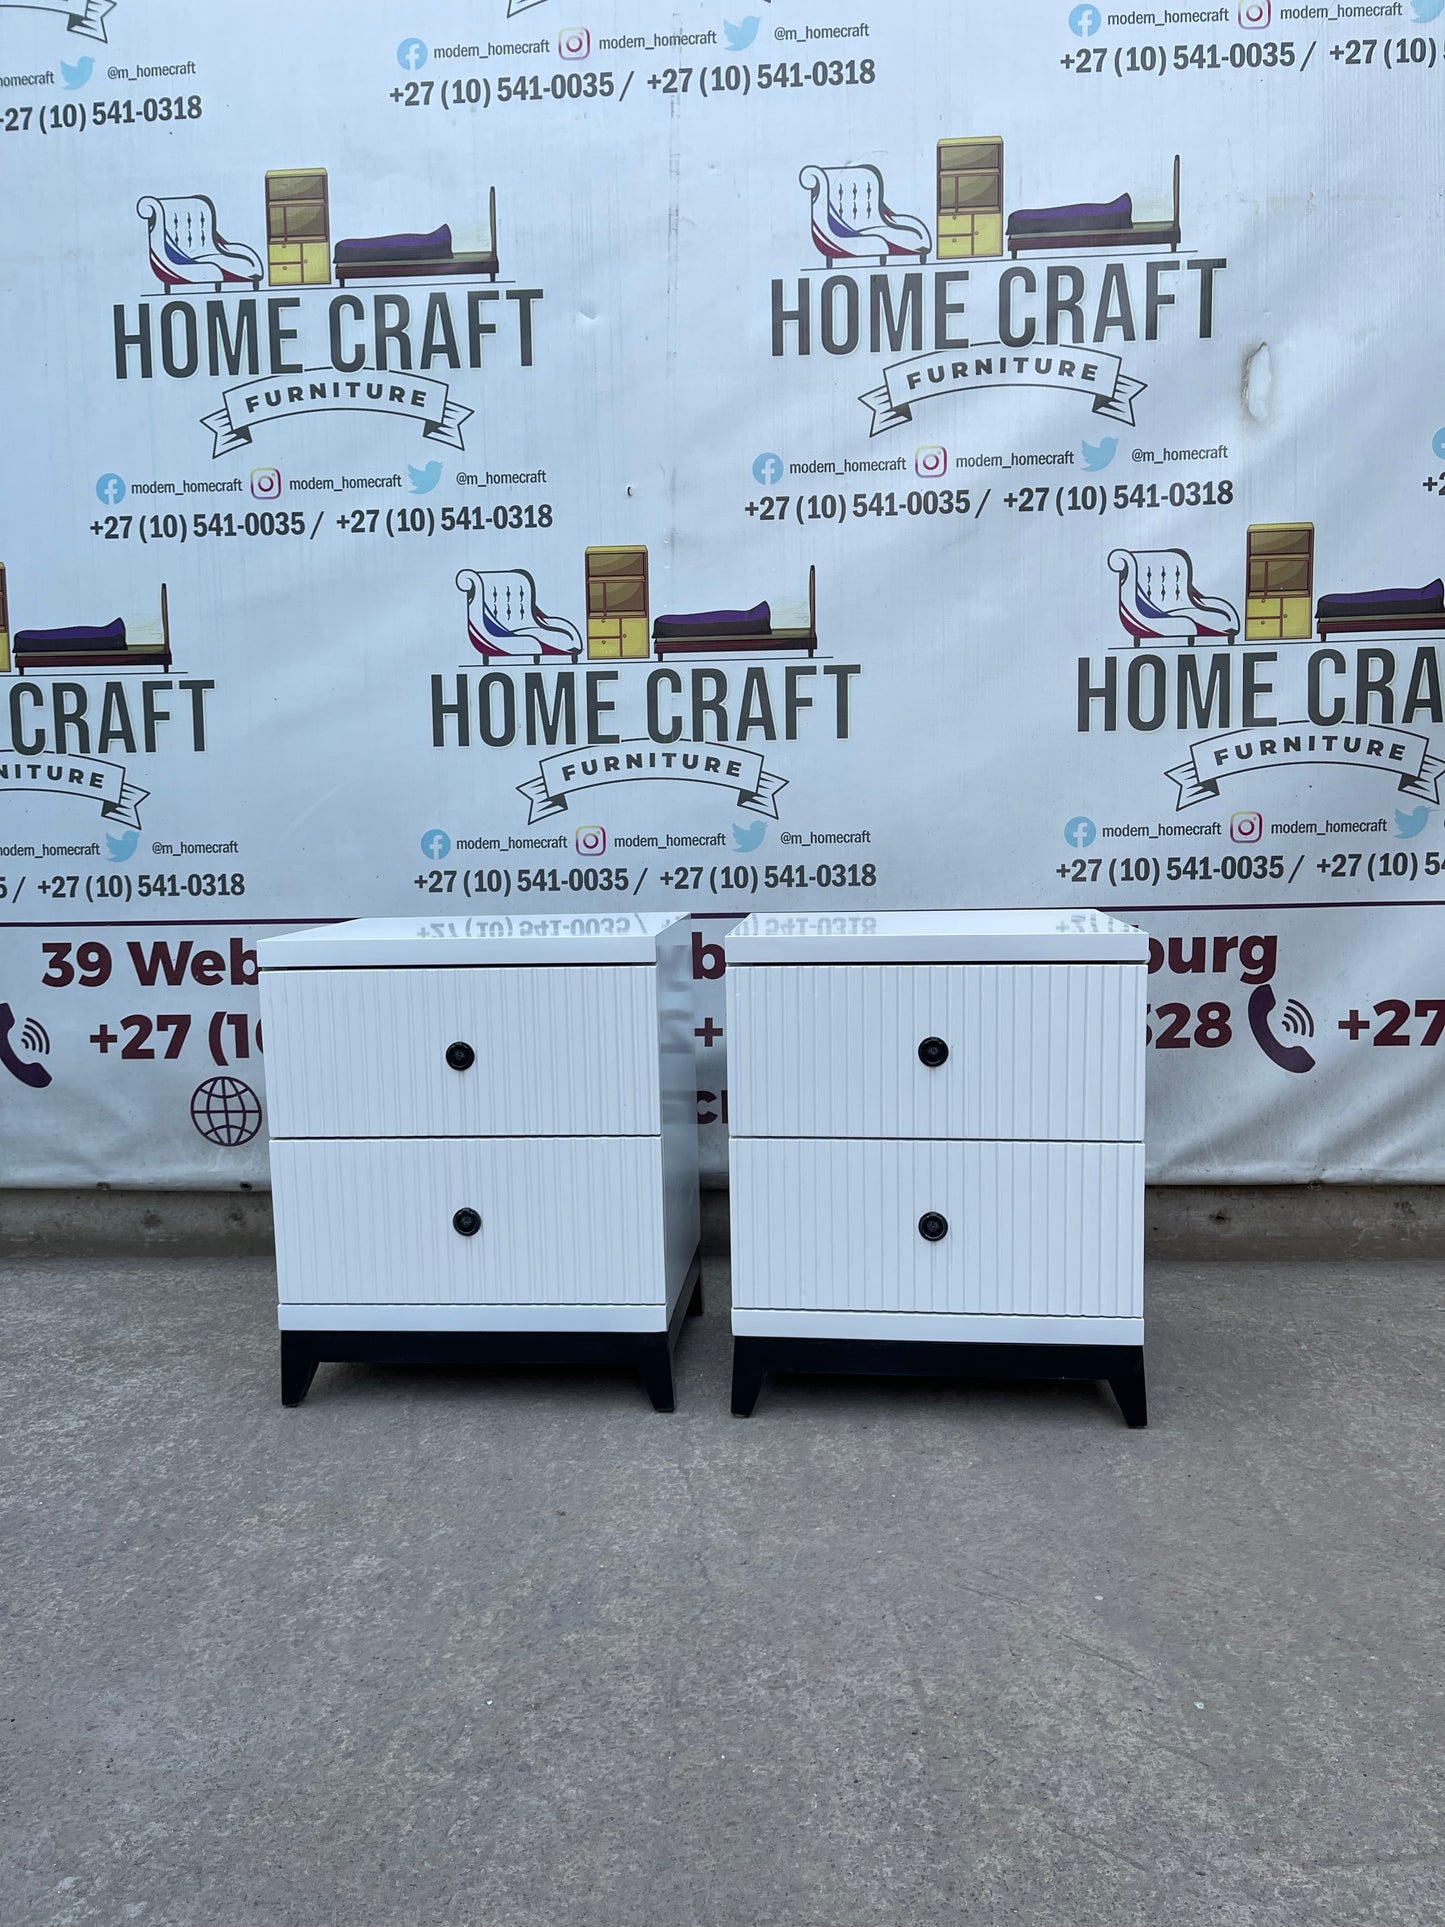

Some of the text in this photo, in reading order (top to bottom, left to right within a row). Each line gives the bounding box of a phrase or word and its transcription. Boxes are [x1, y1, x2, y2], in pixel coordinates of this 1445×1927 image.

[775, 23, 869, 42] @m_homecraft
[108, 61, 195, 80] @m_homecraft
[1061, 48, 1107, 73] +27
[1115, 46, 1166, 77] (10)
[1174, 42, 1295, 69] 541-0035
[1300, 41, 1316, 71] /
[1330, 40, 1377, 64] +27
[1384, 38, 1436, 69] (10)
[390, 59, 875, 110] +27 (10) 541-0035 / +27 (10) 541-0318
[40, 104, 86, 134] (10)
[93, 96, 202, 125] 541-0318
[771, 258, 1227, 357] HOME CRAFT
[114, 289, 544, 379] HOME CRAFT
[906, 356, 1098, 390] FURNITURE
[245, 381, 427, 414] FURNITURE
[1132, 445, 1227, 464] @m_homecraft
[457, 470, 546, 487] @m_homecraft
[745, 480, 1233, 524] +27 (10) 541-0035 / +27 (10) 541-0318
[90, 504, 552, 543] +27 (10) 541-0035 / +27 (10) 541-0318
[431, 665, 861, 747] HOME CRAFT
[1078, 652, 1277, 732] HOME
[9, 680, 214, 755] CRAFT
[562, 752, 742, 781] FURNITURE
[1214, 736, 1405, 766] FURNITURE
[152, 841, 238, 856] @m_homecraft
[781, 830, 871, 846] @m_homecraft
[414, 864, 876, 897] +27 (10) 541-0035 / +27 (10) 541-0318
[1056, 859, 1102, 882] +27
[1109, 858, 1159, 886] (10)
[1167, 856, 1284, 880] 541-0035
[1288, 855, 1305, 883] /
[1317, 854, 1362, 877] +27
[1368, 853, 1417, 881] (10)
[12, 877, 25, 903] /
[38, 876, 79, 898] +27
[86, 875, 132, 902] (10)
[138, 873, 245, 897] 541-0318
[42, 942, 112, 987] 39
[90, 1015, 191, 1059] +27
[207, 1010, 263, 1067] (1
